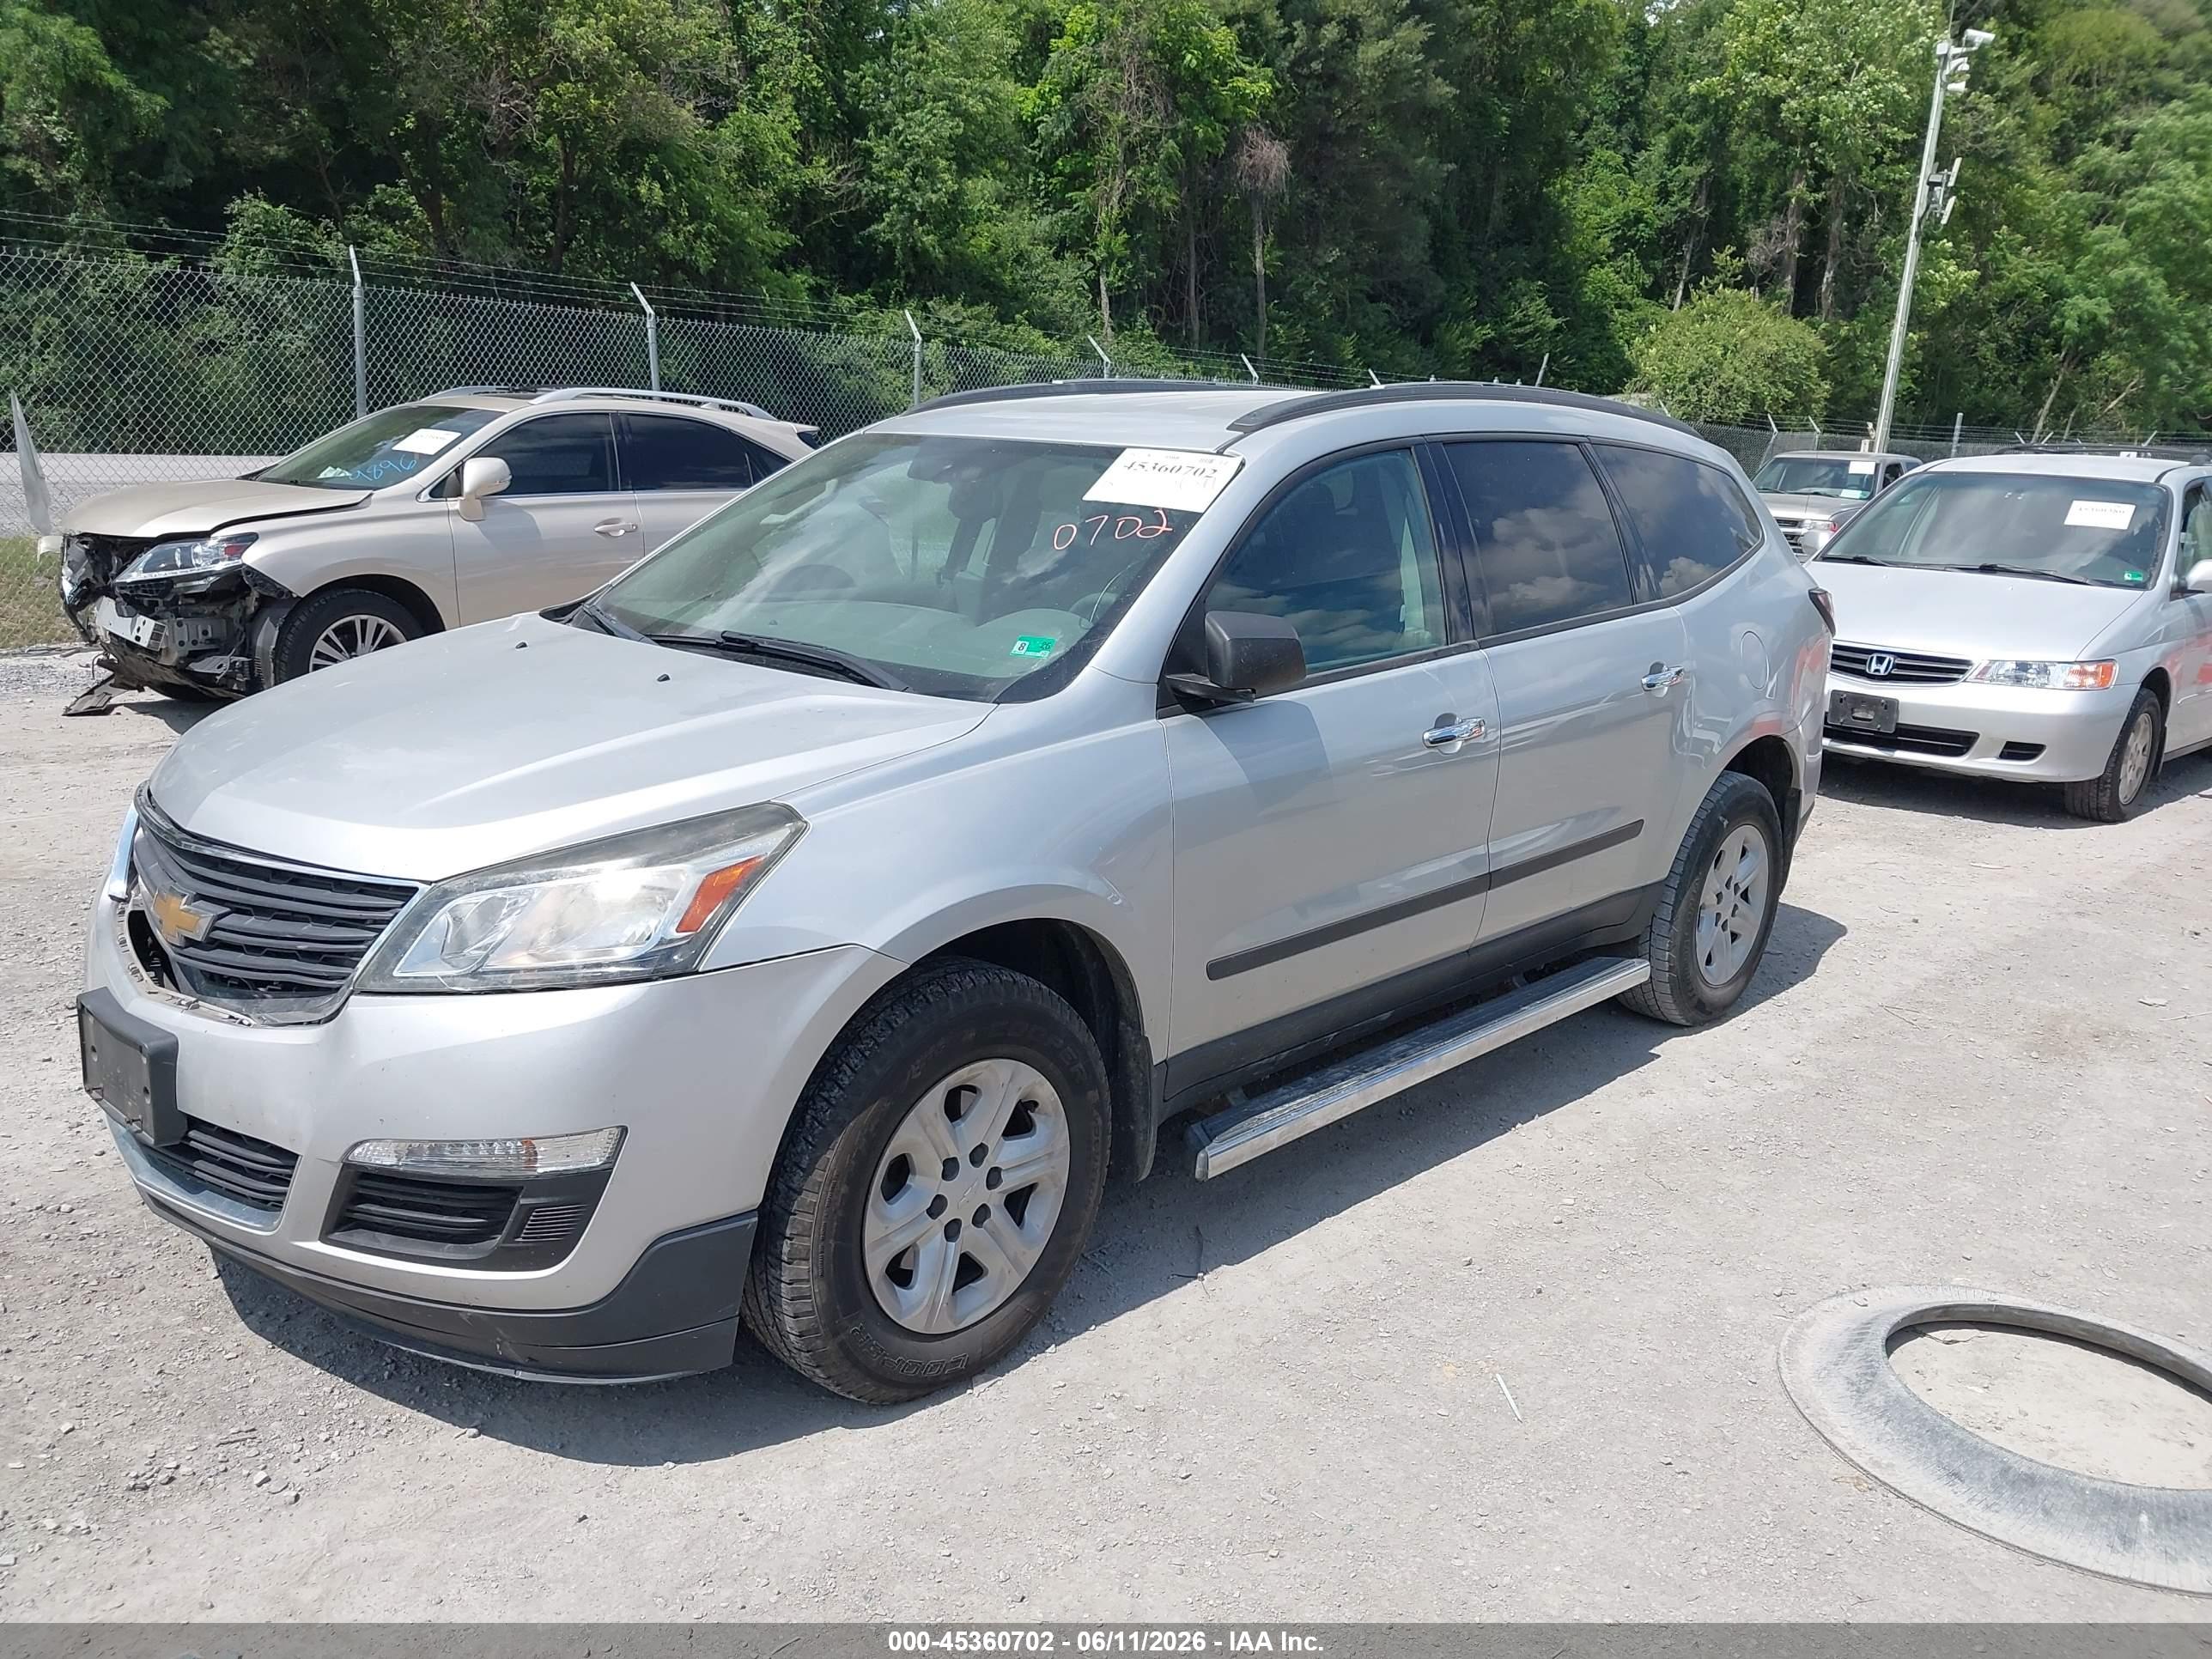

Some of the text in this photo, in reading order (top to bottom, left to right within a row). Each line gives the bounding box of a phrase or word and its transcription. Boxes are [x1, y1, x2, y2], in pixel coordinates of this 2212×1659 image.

[349, 454, 417, 482] 9896
[1123, 460, 1218, 478] 45360702
[1054, 507, 1173, 550] 0702
[1018, 642, 1027, 651] 8
[849, 1322, 969, 1376] COOPER
